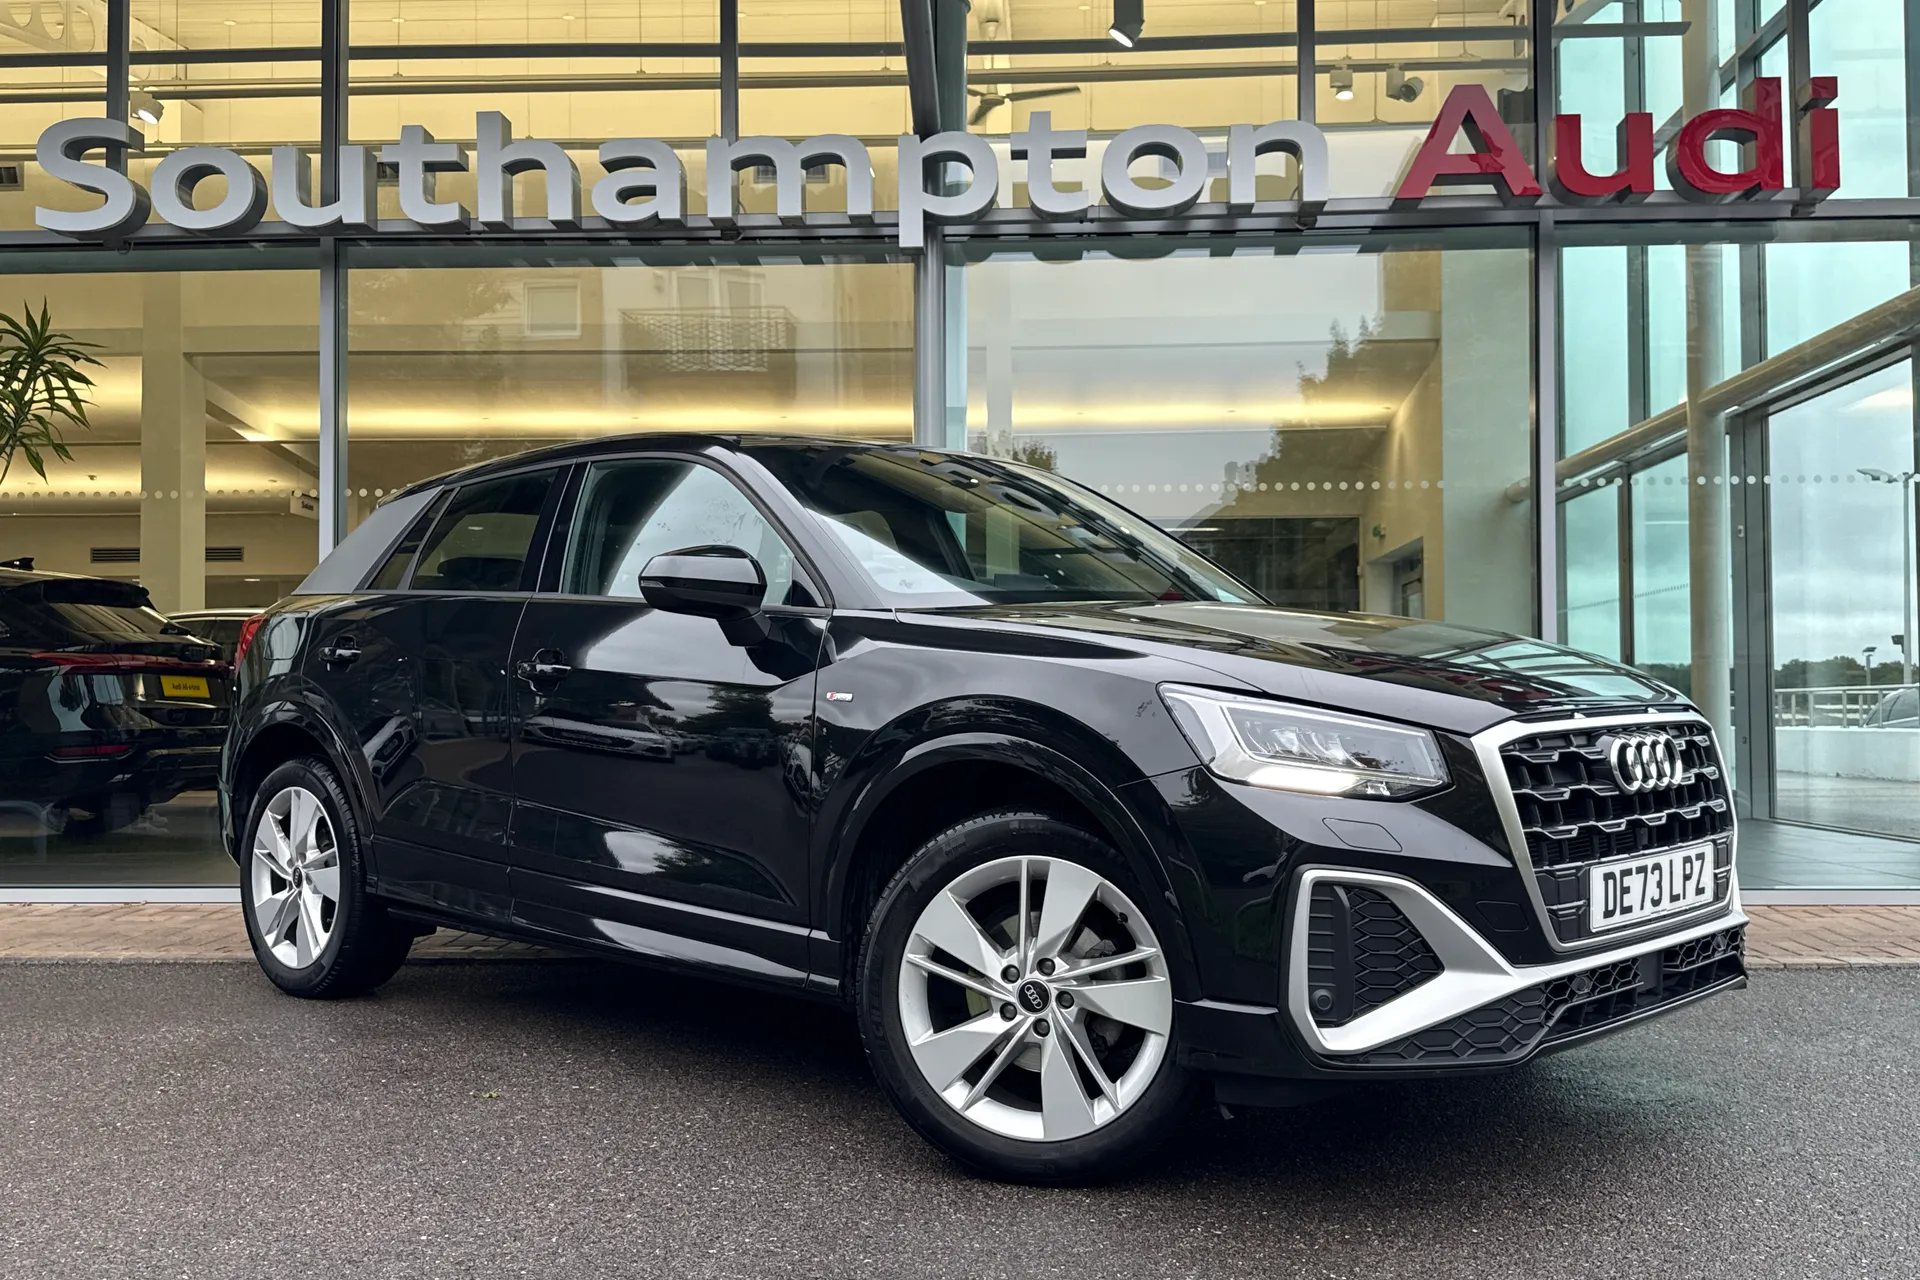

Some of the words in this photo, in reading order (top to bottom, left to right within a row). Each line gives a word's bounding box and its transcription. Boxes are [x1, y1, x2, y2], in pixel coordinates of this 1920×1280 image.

[35, 110, 1328, 250] Southampton
[1394, 76, 1841, 200] Audi
[1602, 862, 1663, 919] DE73
[1669, 852, 1706, 903] LPZ
